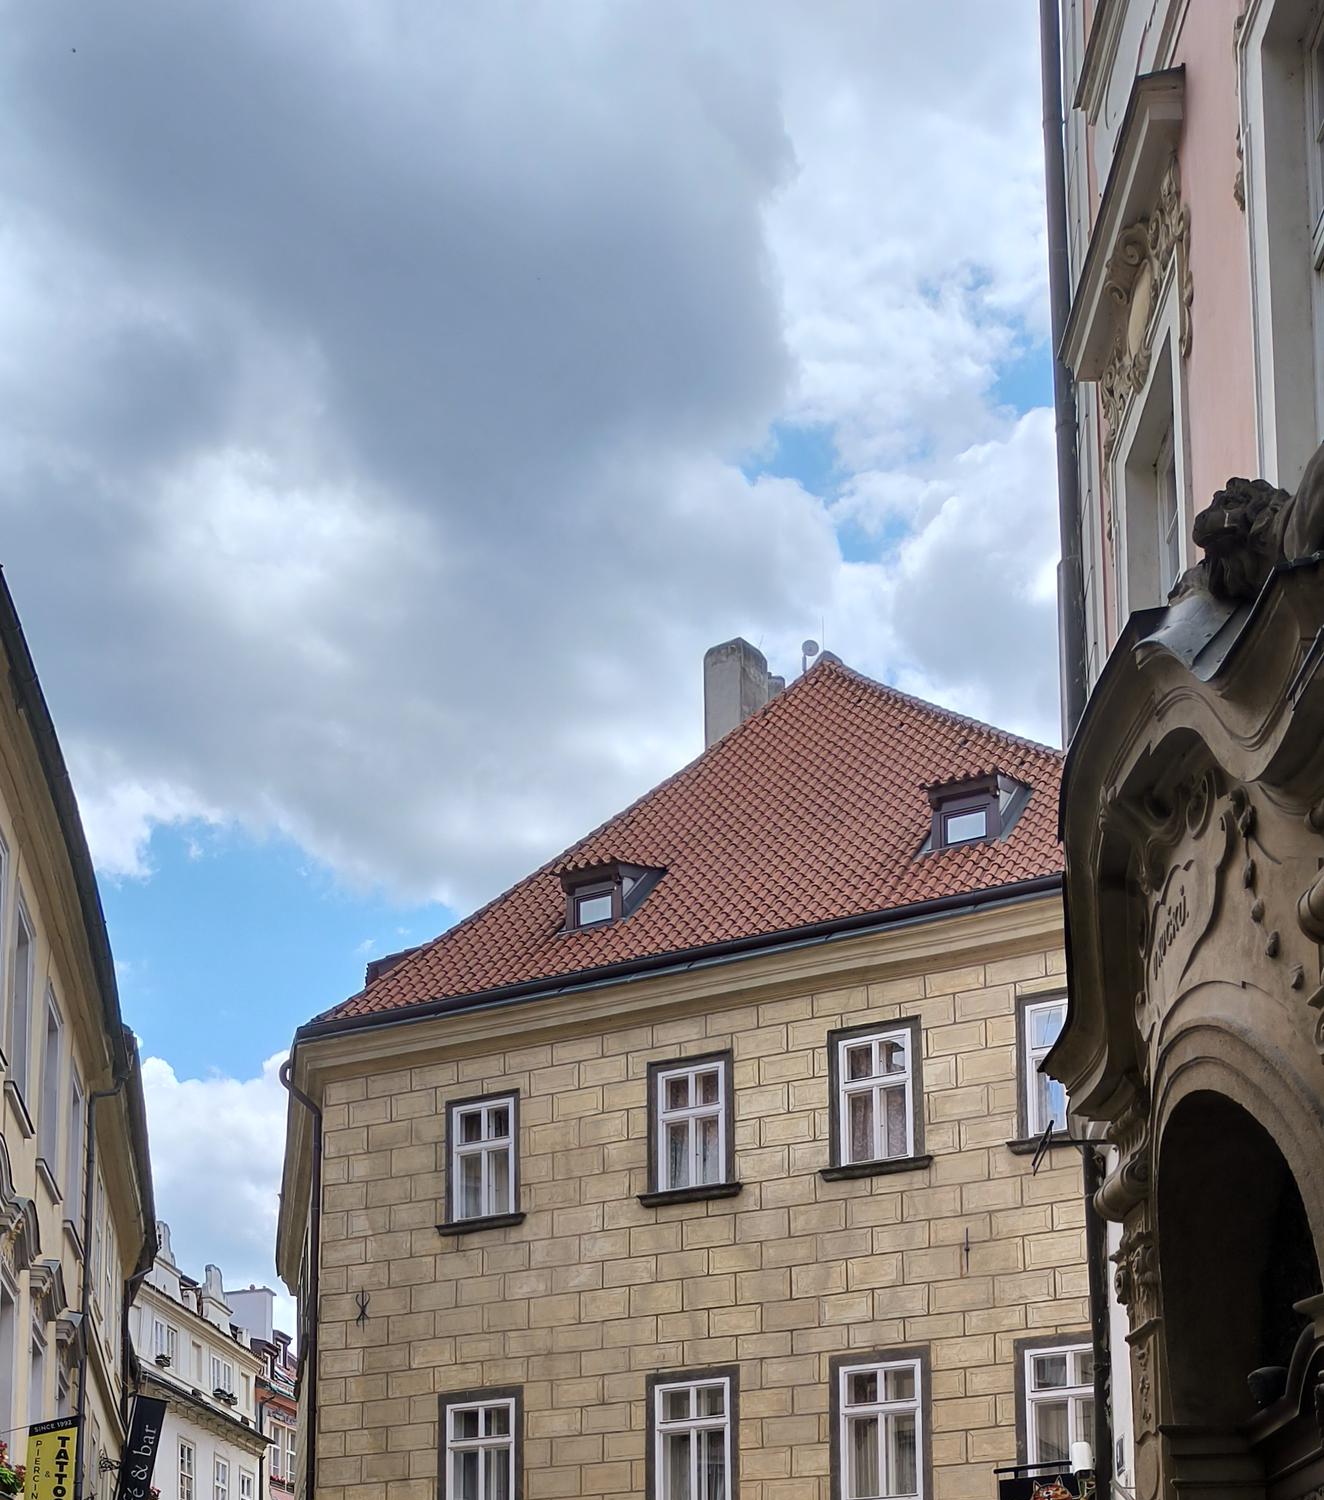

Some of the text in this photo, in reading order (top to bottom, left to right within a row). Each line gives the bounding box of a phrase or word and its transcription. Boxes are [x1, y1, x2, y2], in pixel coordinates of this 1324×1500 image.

[34, 1422, 56, 1433] SINCE
[133, 1424, 157, 1457] bar
[45, 1470, 51, 1478] &
[131, 1464, 149, 1481] &
